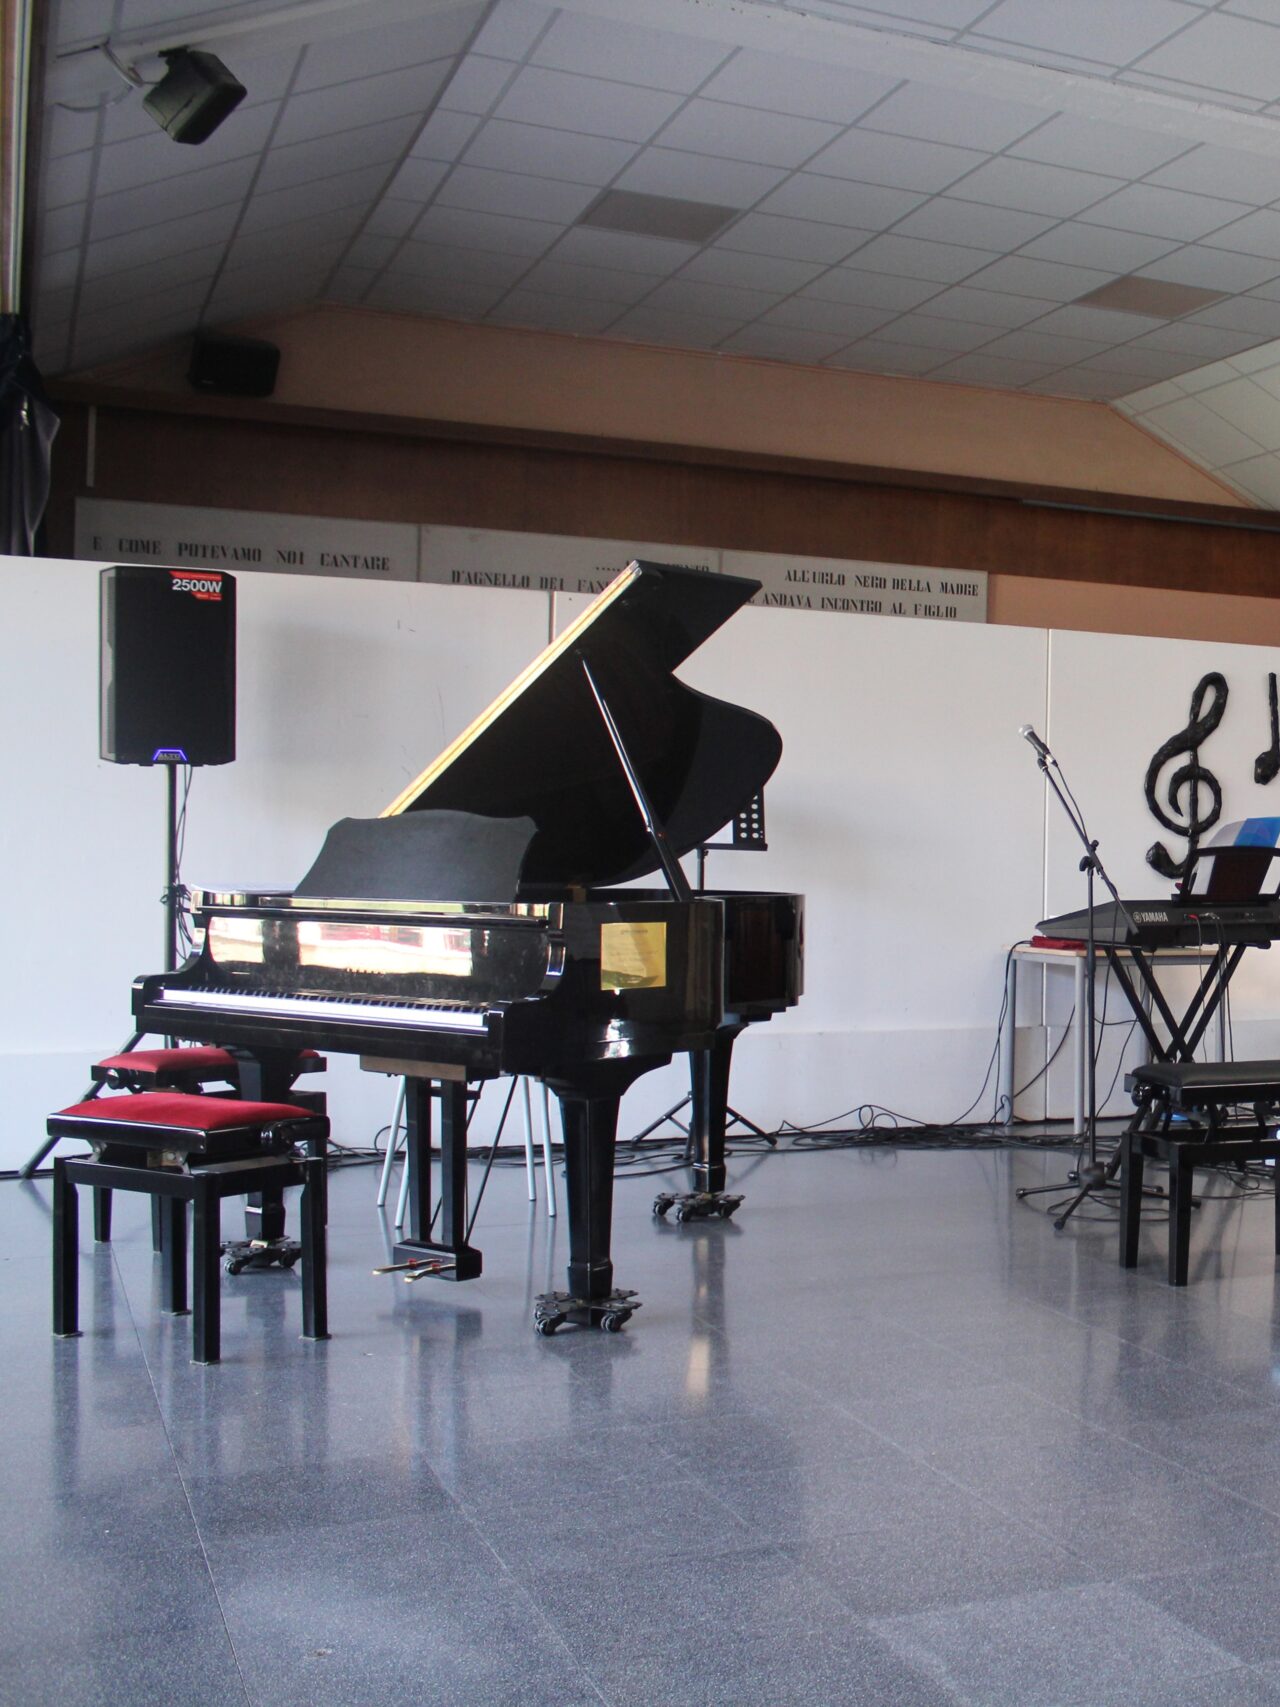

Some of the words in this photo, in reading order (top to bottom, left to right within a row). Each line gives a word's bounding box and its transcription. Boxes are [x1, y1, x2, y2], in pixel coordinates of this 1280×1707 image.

[93, 536, 102, 551] E
[119, 538, 161, 555] COME
[177, 542, 262, 562] POTEVAMO
[277, 550, 305, 565] NOI
[320, 553, 390, 571] CANTARE
[172, 578, 222, 593] 2500W
[452, 570, 530, 590] D'AGNELLO
[540, 577, 564, 591] DEI
[855, 574, 887, 589] NERO
[892, 578, 932, 593] DELLA
[940, 581, 979, 597] MADRE
[763, 593, 812, 608] ANDAVA
[821, 597, 882, 613] INCONTRO
[891, 602, 906, 615] AL
[914, 603, 957, 618] FIGLIO
[1141, 911, 1169, 923] YAMAHA
